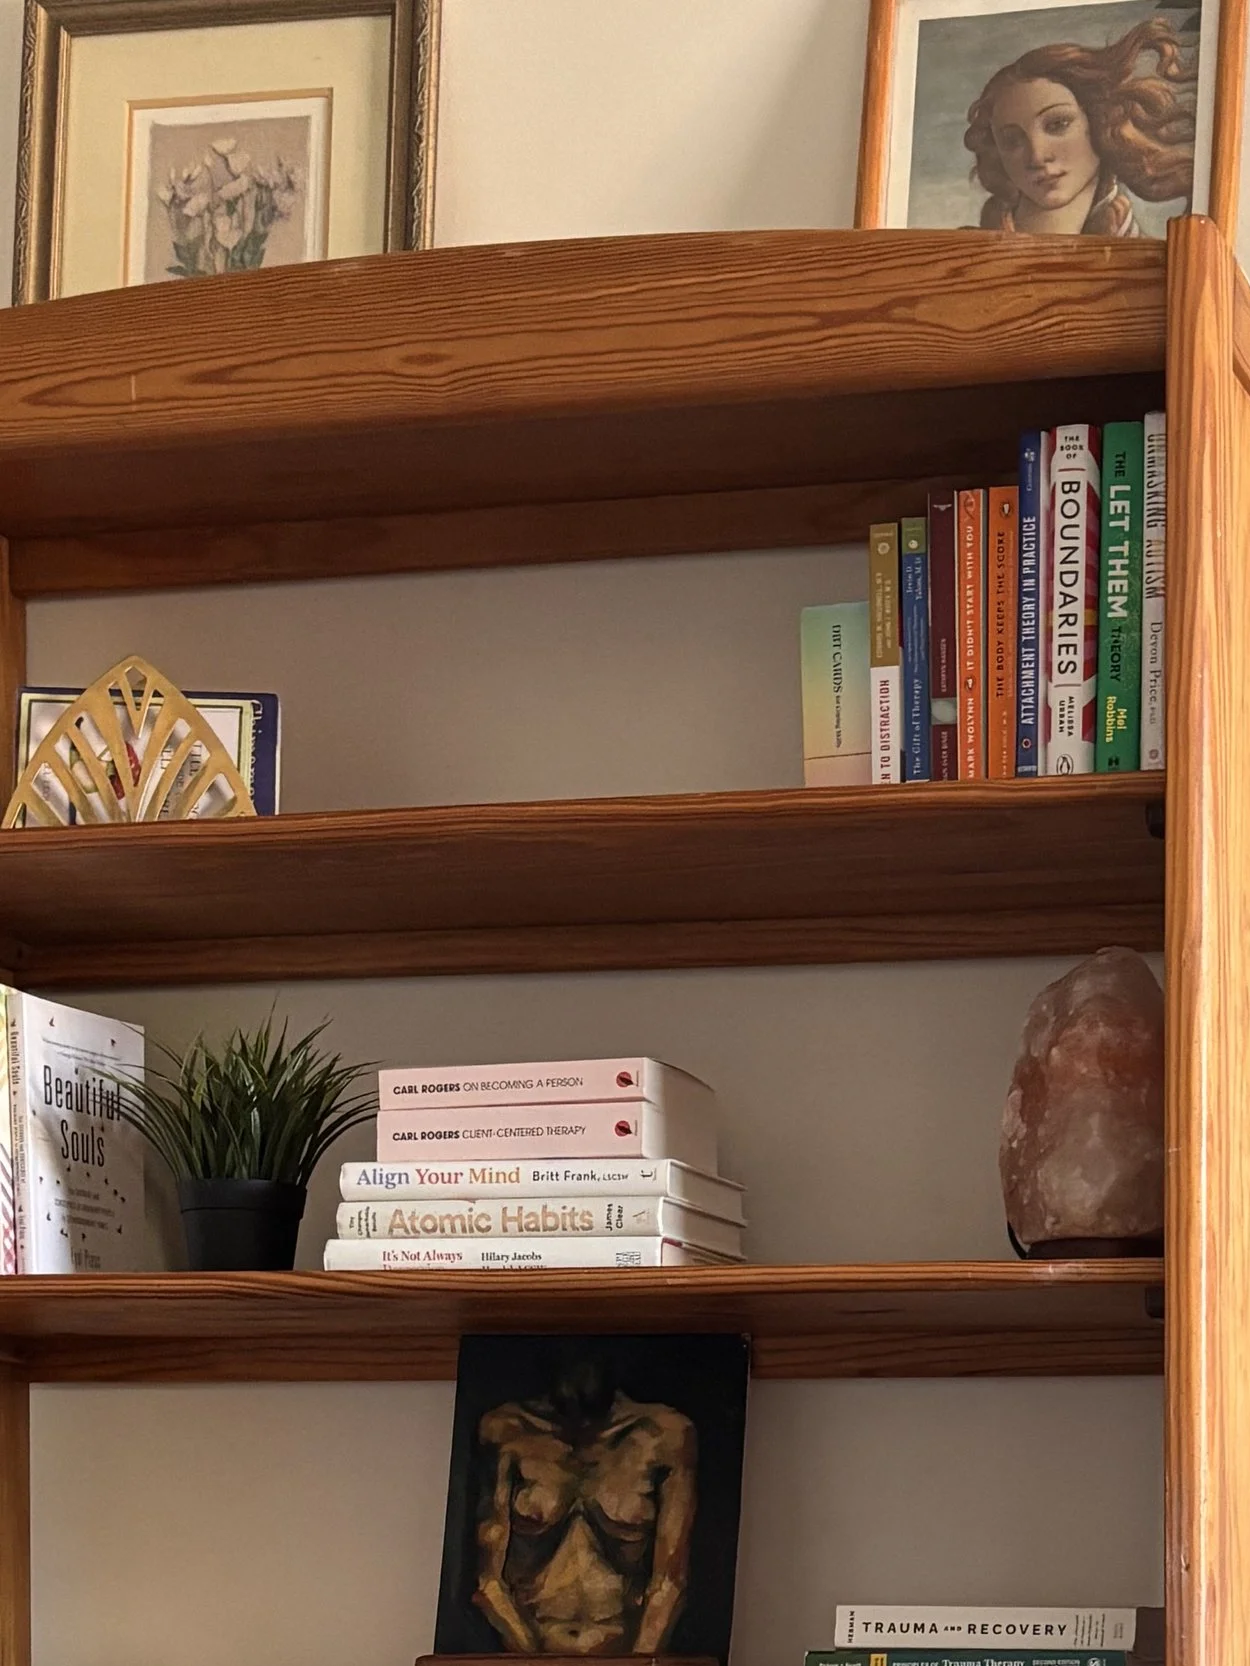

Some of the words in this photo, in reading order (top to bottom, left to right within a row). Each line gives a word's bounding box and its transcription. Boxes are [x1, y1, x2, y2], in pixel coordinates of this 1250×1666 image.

[1064, 435, 1080, 443] THE
[1114, 451, 1126, 478] THE
[1146, 433, 1166, 529] UNMASKING
[1109, 484, 1131, 532] LET
[966, 525, 974, 548] YOU
[996, 531, 1005, 568] SCORE
[1022, 516, 1036, 574] PRACTICE
[966, 552, 974, 579] WITH
[1058, 480, 1081, 675] BOUNDARIES
[1107, 540, 1130, 618] THEM
[1145, 539, 1165, 600] AUTISM
[996, 575, 1005, 595] THE
[1022, 577, 1035, 591] IN
[966, 584, 974, 615] START
[996, 601, 1005, 634] KEEPS
[1021, 597, 1036, 642] THEORY
[996, 640, 1004, 671] BODY
[1110, 626, 1122, 683] THEORY
[1149, 622, 1163, 664] Devon
[966, 661, 975, 670] IT
[912, 679, 923, 721] Therapy
[996, 677, 1004, 697] THE
[1020, 648, 1036, 725] ATTACHMENT
[879, 679, 890, 751] DISTRACTION
[912, 721, 921, 732] of
[966, 698, 975, 743] WOLYNN
[1067, 696, 1075, 737] MELISSA
[1106, 696, 1117, 743] Robbins
[1116, 708, 1128, 730] Mel
[912, 732, 921, 754] Gift
[880, 756, 891, 769] TO
[913, 756, 921, 775] The
[966, 752, 975, 779] MARK
[43, 1065, 120, 1121] Beautiful
[393, 1084, 419, 1095] CARL
[421, 1082, 461, 1094] ROGERS
[462, 1081, 479, 1092] ON
[480, 1079, 534, 1091] BECOMING
[535, 1078, 544, 1089] A
[545, 1076, 584, 1087] PERSON
[60, 1119, 105, 1167] Souls
[392, 1131, 418, 1141] CARL
[420, 1130, 460, 1141] ROGERS
[546, 1125, 586, 1136] THERAPY
[356, 1167, 410, 1190] Align
[415, 1168, 464, 1185] Your
[469, 1166, 520, 1184] Mind
[532, 1170, 560, 1182] Britt
[563, 1170, 600, 1182] Frank,
[387, 1206, 492, 1236] Atomic
[501, 1203, 594, 1233] Habits
[605, 1203, 613, 1232] James
[615, 1205, 624, 1229] Clear
[382, 1250, 399, 1262] It's
[400, 1251, 421, 1261] Not
[423, 1249, 463, 1264] Always
[481, 1252, 510, 1263] Hilary
[511, 1251, 543, 1262] Jacobs
[847, 1610, 855, 1644] HERMAN
[862, 1622, 938, 1634] TRAUMA
[967, 1623, 1068, 1636] RECOVERY
